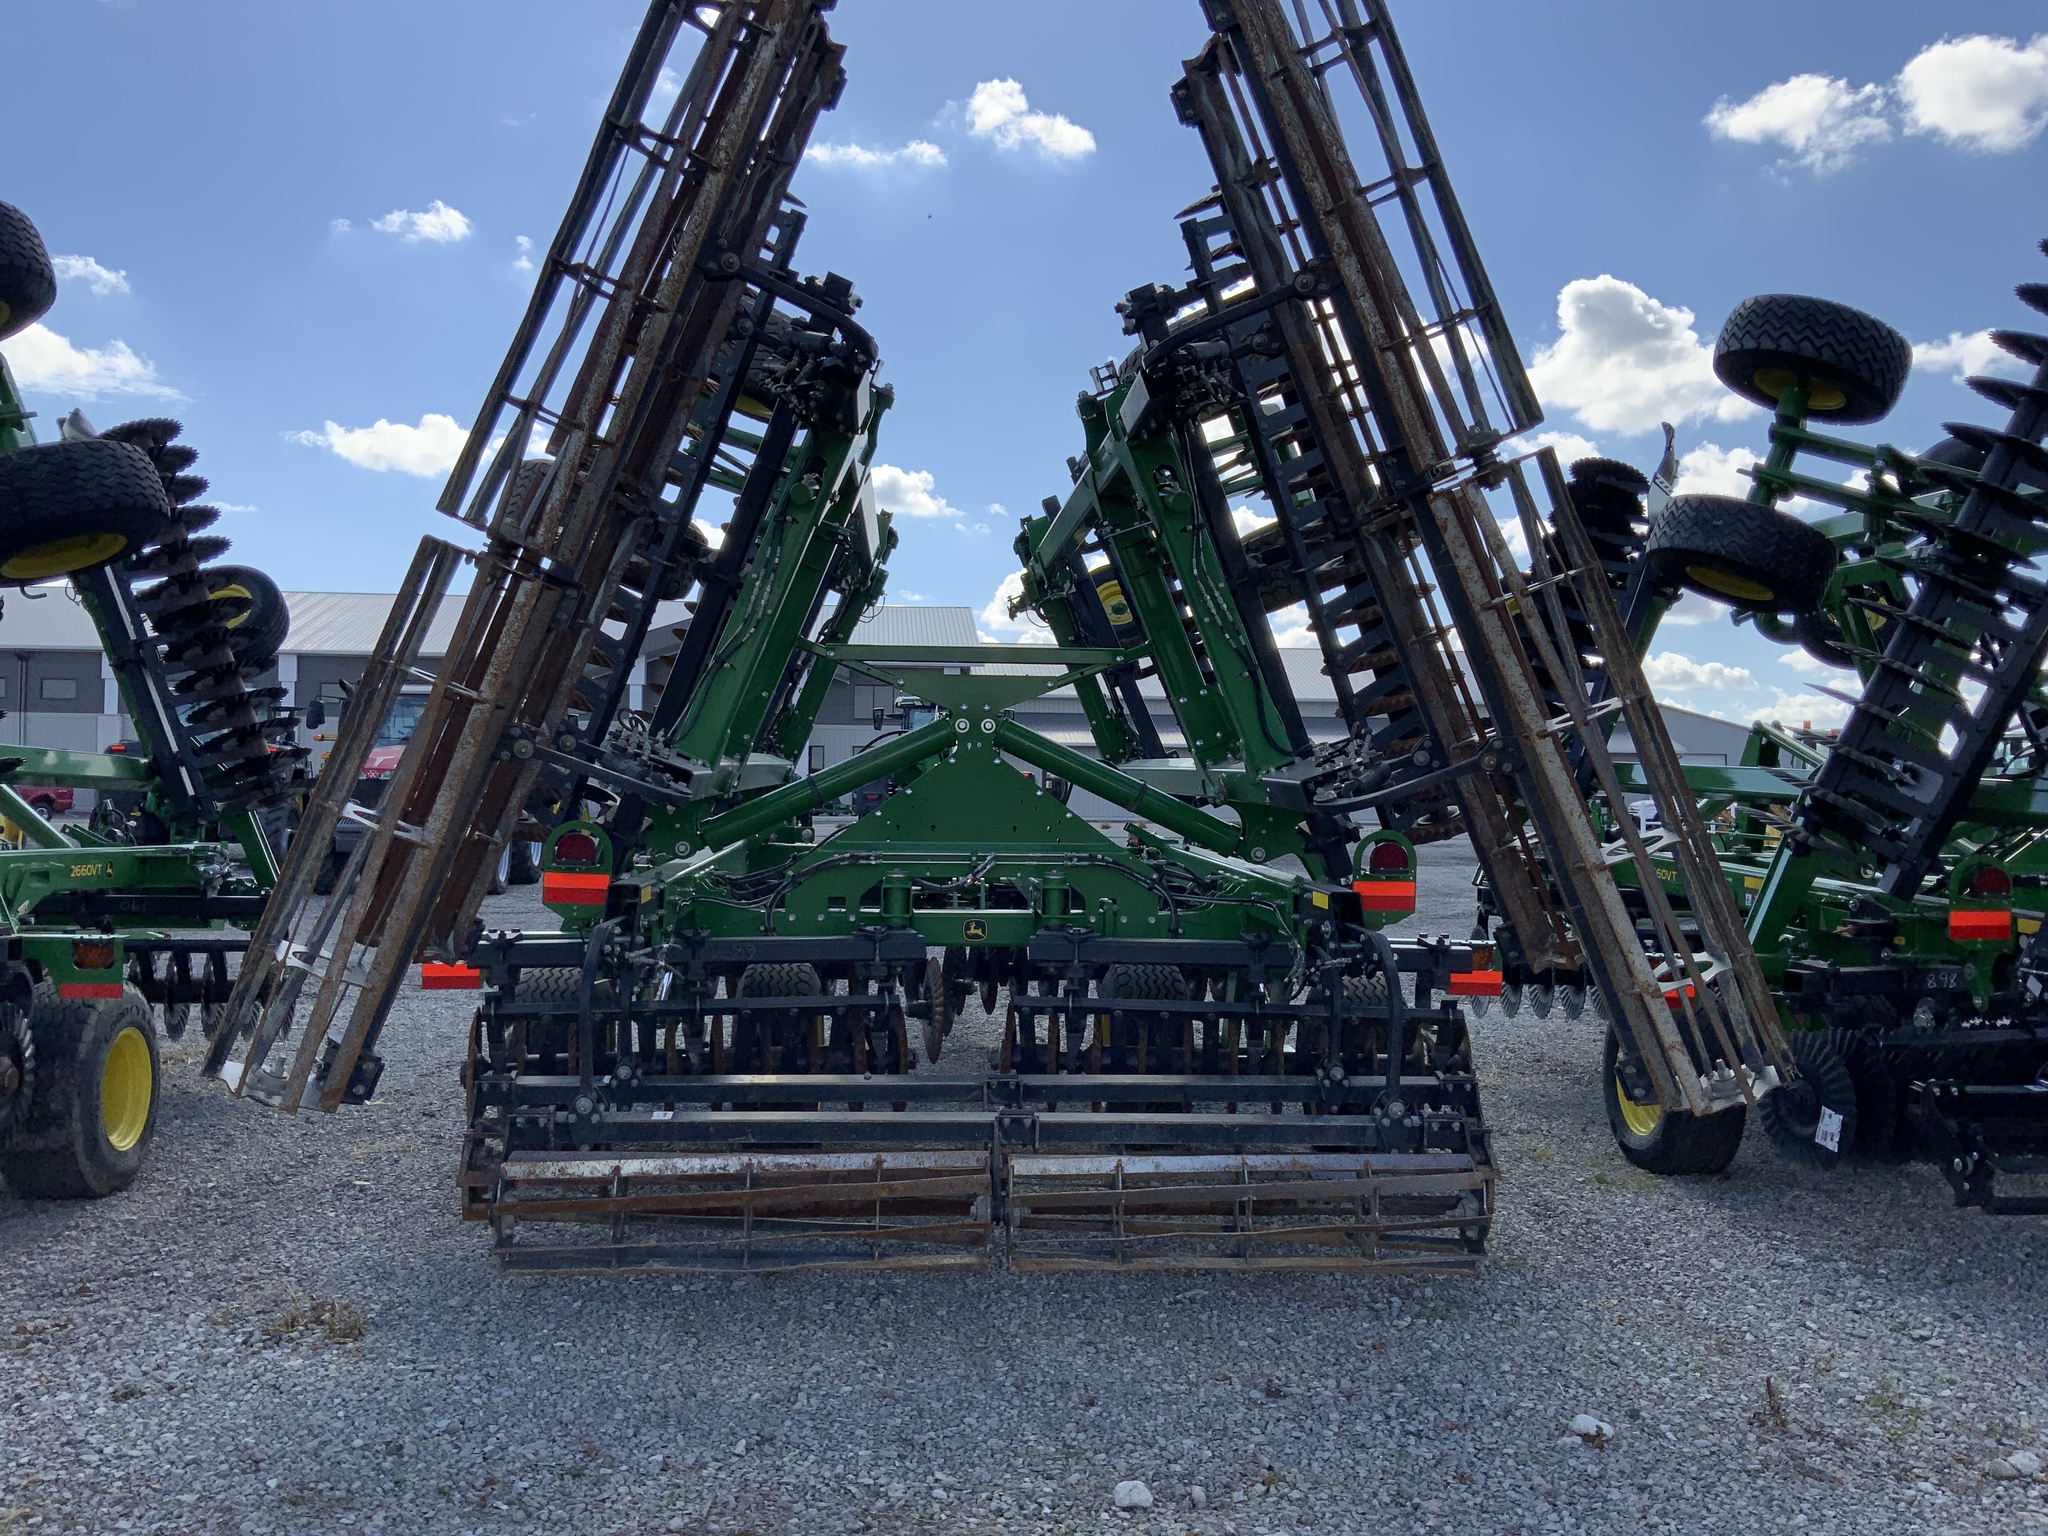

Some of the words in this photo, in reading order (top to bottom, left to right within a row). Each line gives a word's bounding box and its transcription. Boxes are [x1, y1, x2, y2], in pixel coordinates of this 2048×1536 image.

[70, 863, 103, 878] 2660VT
[1654, 868, 1677, 881] 60VT
[1926, 972, 1958, 989] 898
